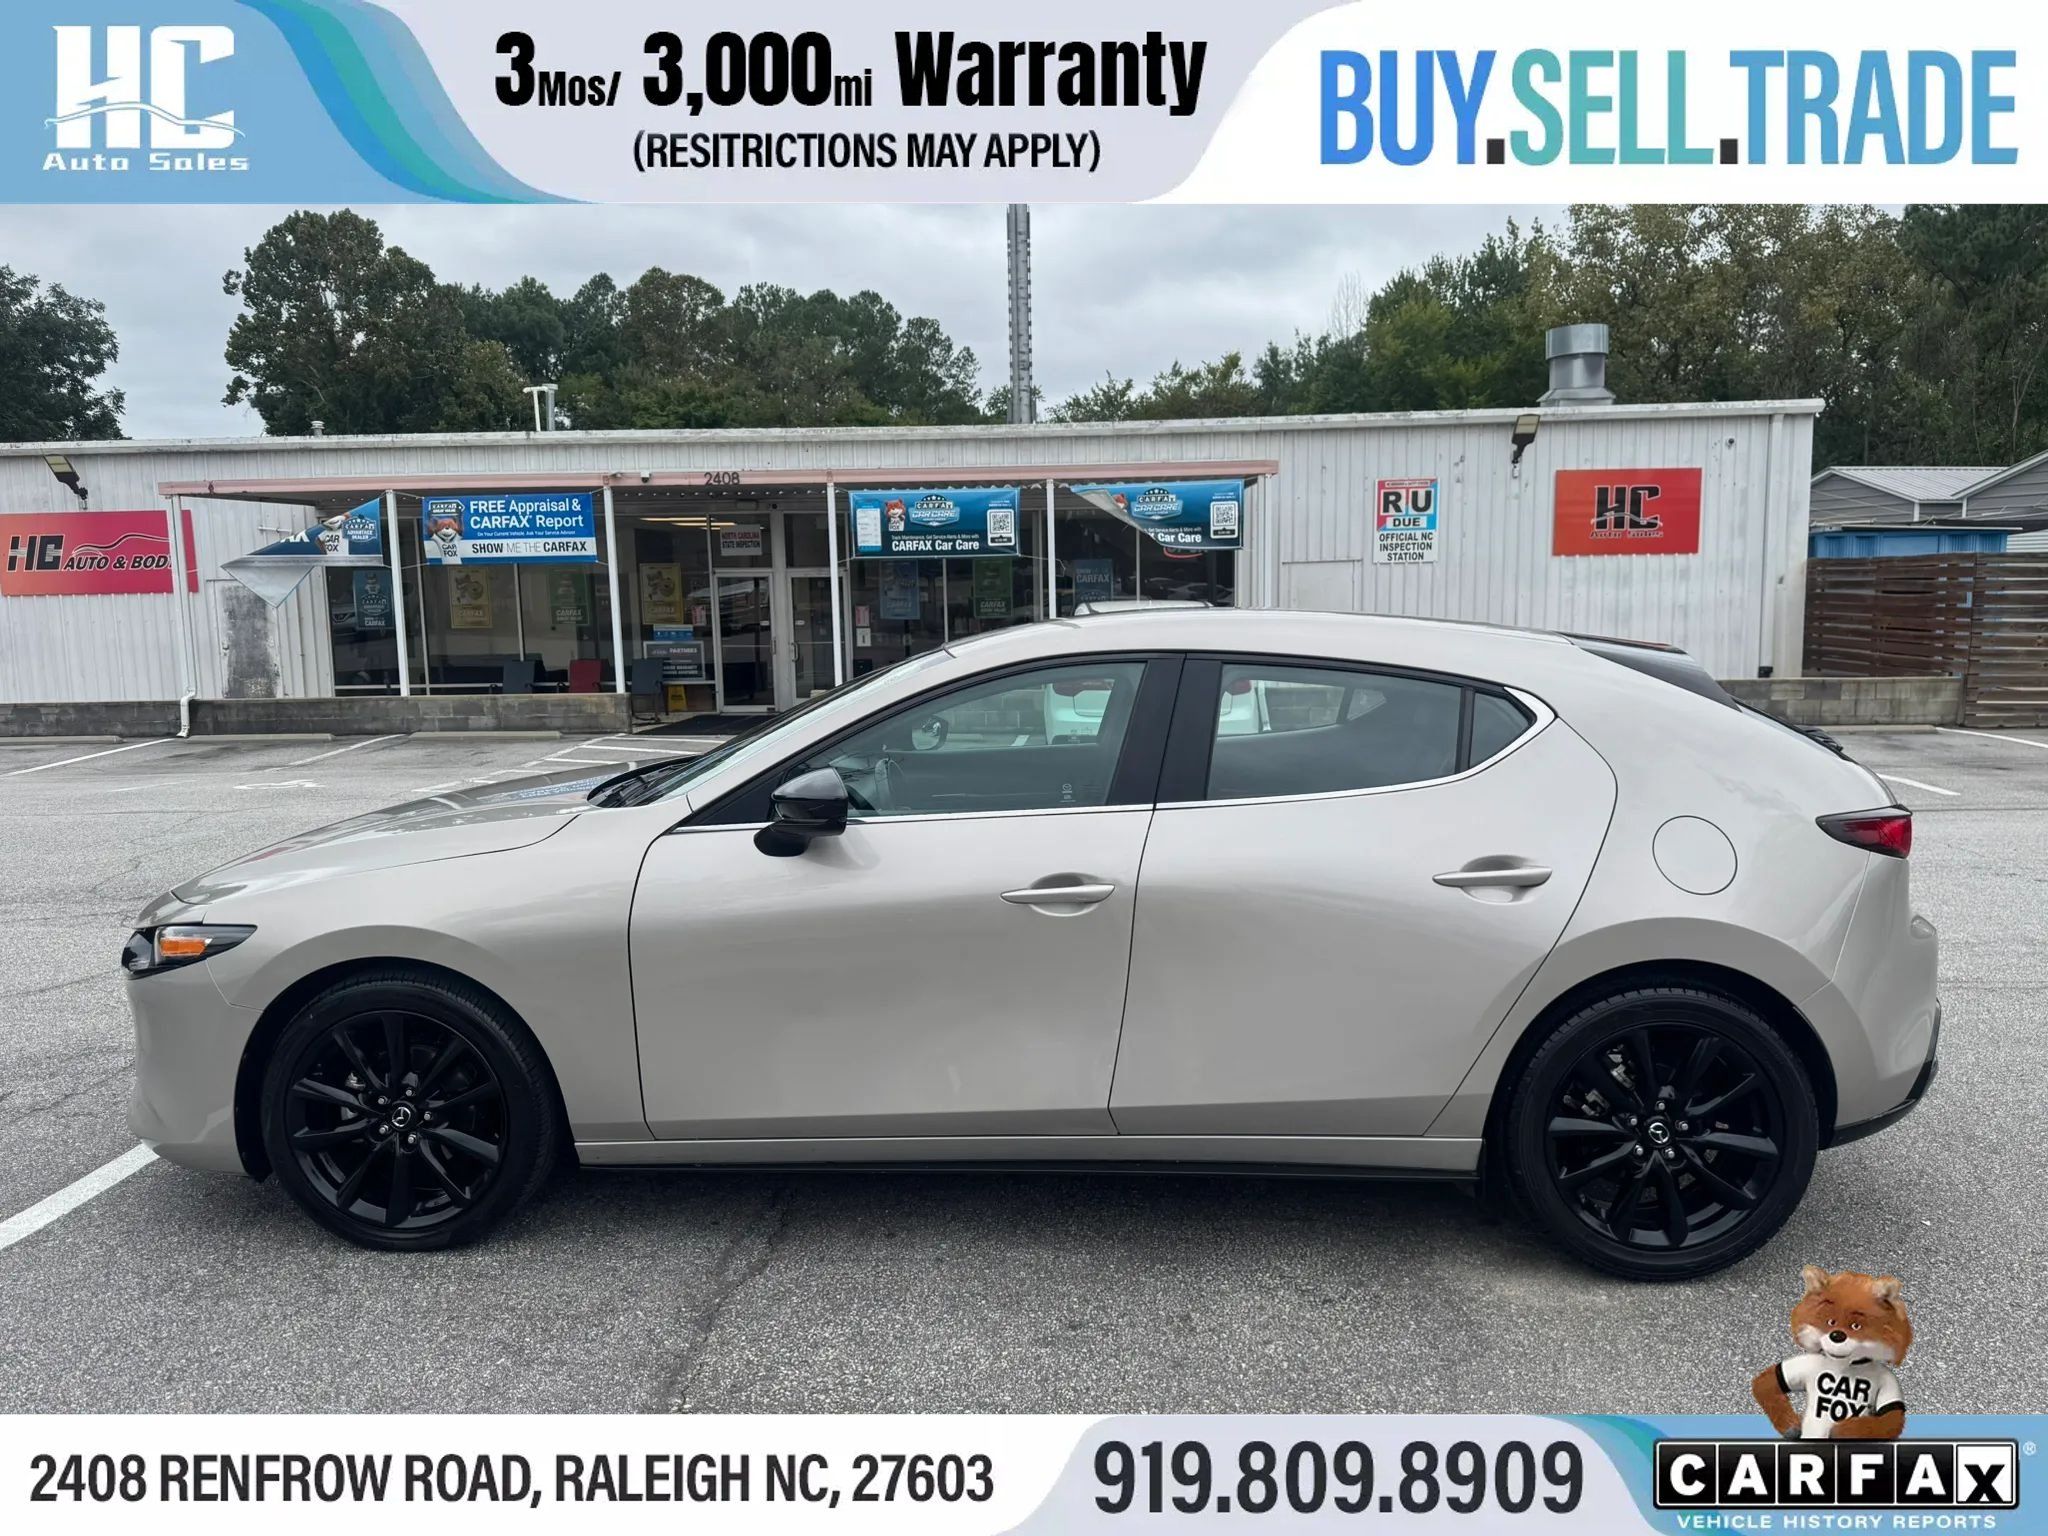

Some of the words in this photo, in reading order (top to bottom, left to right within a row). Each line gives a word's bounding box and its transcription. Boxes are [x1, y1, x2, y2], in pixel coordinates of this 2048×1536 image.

[704, 471, 740, 486] 2408
[470, 500, 506, 513] FREE
[509, 498, 570, 515] Appraisal
[571, 498, 582, 511] &
[1594, 485, 1661, 531] HC
[536, 515, 584, 530] Report
[1392, 518, 1421, 527] DUE
[1158, 532, 1175, 542] Car
[1178, 532, 1202, 542] Care
[1379, 533, 1418, 542] OFFICIAL
[1421, 532, 1434, 541] NC
[472, 543, 503, 554] SHOW
[507, 542, 520, 553] ME
[522, 542, 541, 552] THE
[543, 541, 587, 552] CARFAX
[892, 540, 932, 551] CARFAX
[935, 540, 953, 550] Car
[956, 539, 979, 550] Care
[1380, 542, 1433, 552] INSPECTION
[1387, 552, 1424, 561] STATION
[63, 555, 109, 571] AUTO
[112, 555, 127, 570] &
[1076, 574, 1110, 583] CARFAX
